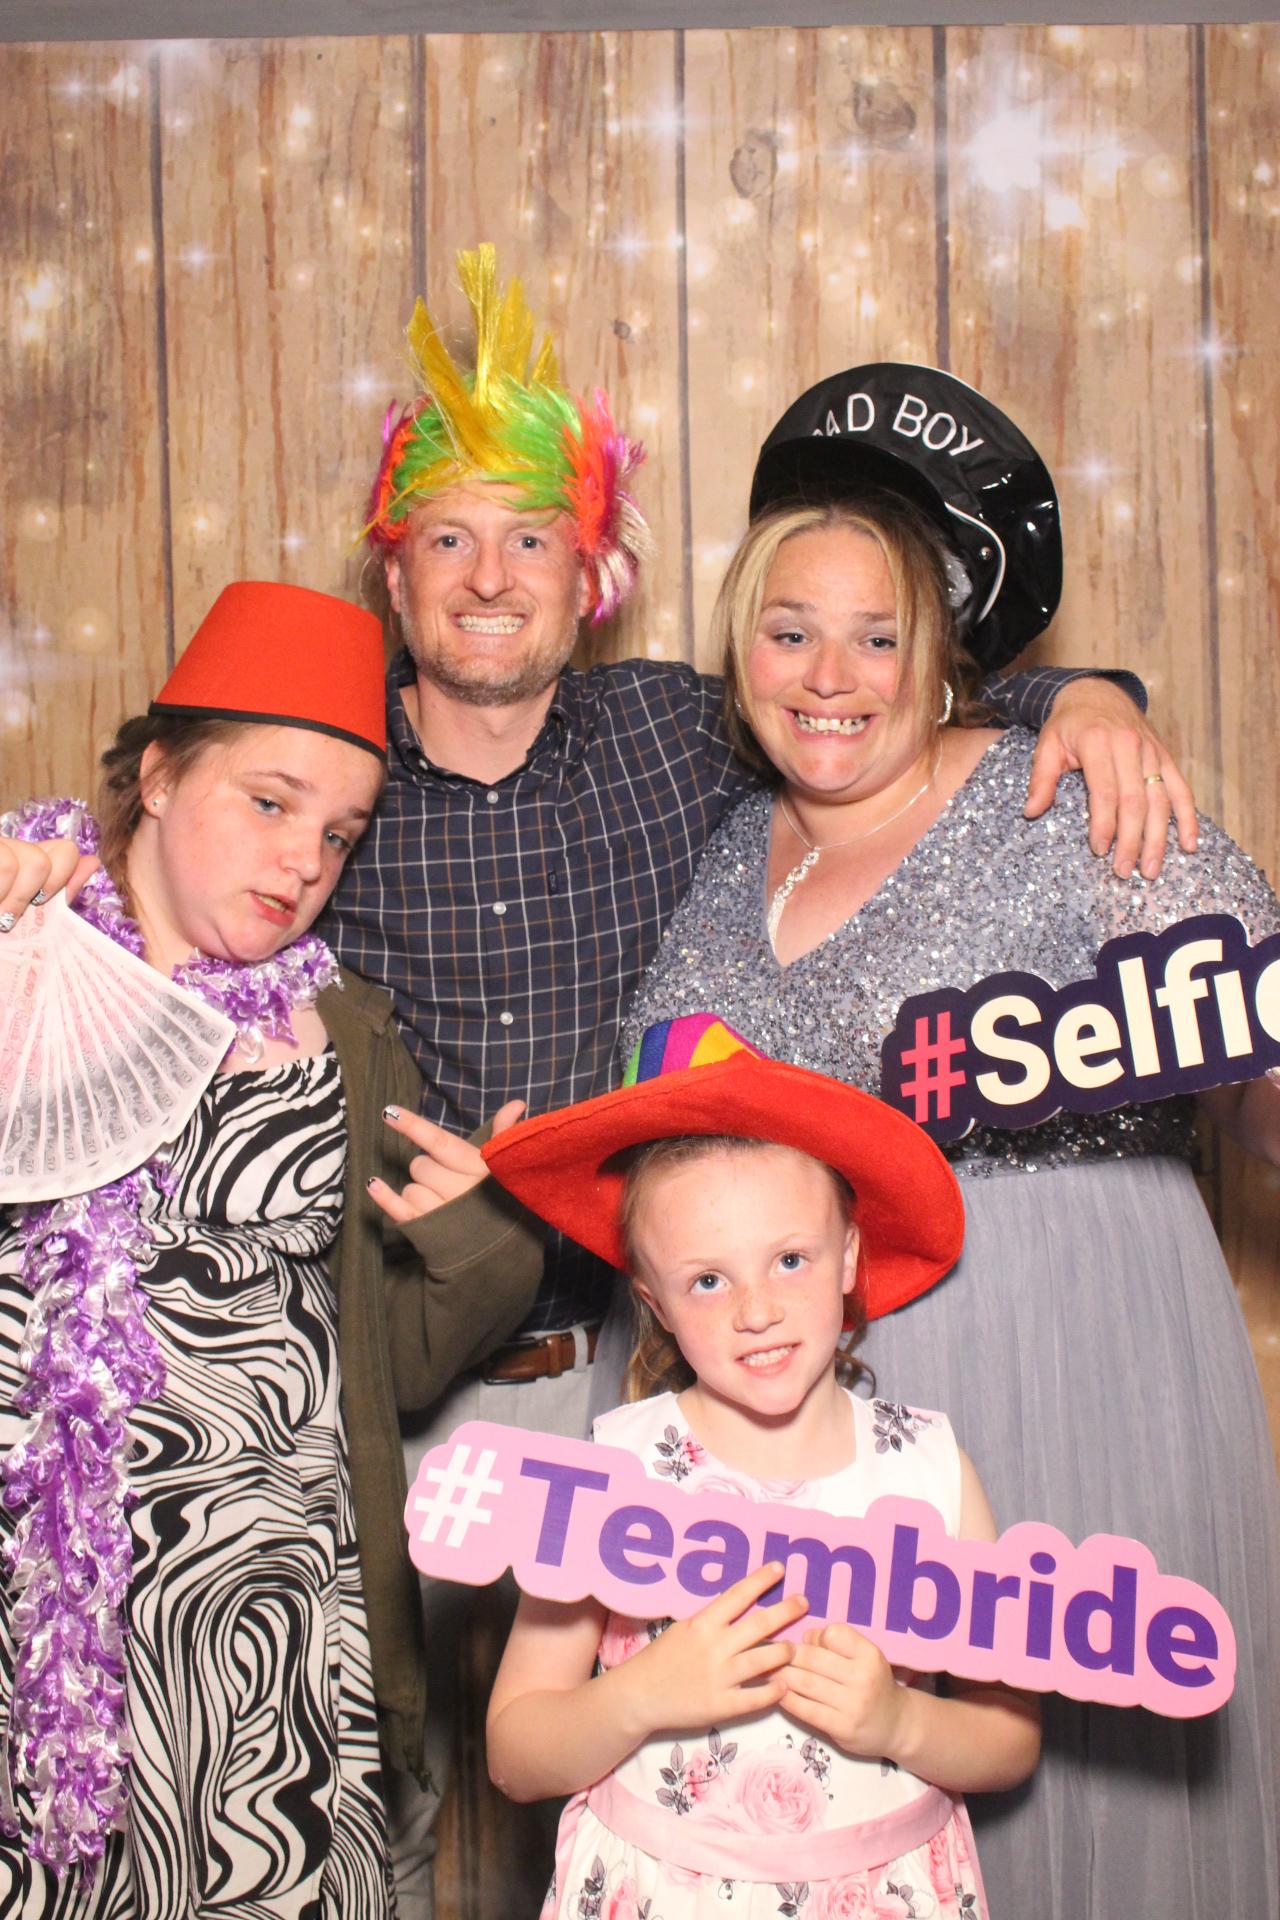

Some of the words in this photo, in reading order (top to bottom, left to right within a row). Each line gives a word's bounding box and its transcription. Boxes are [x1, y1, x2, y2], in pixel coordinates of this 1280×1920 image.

[812, 392, 876, 436] AD
[892, 393, 985, 457] BOY
[414, 1443, 1220, 1689] #Teambride
